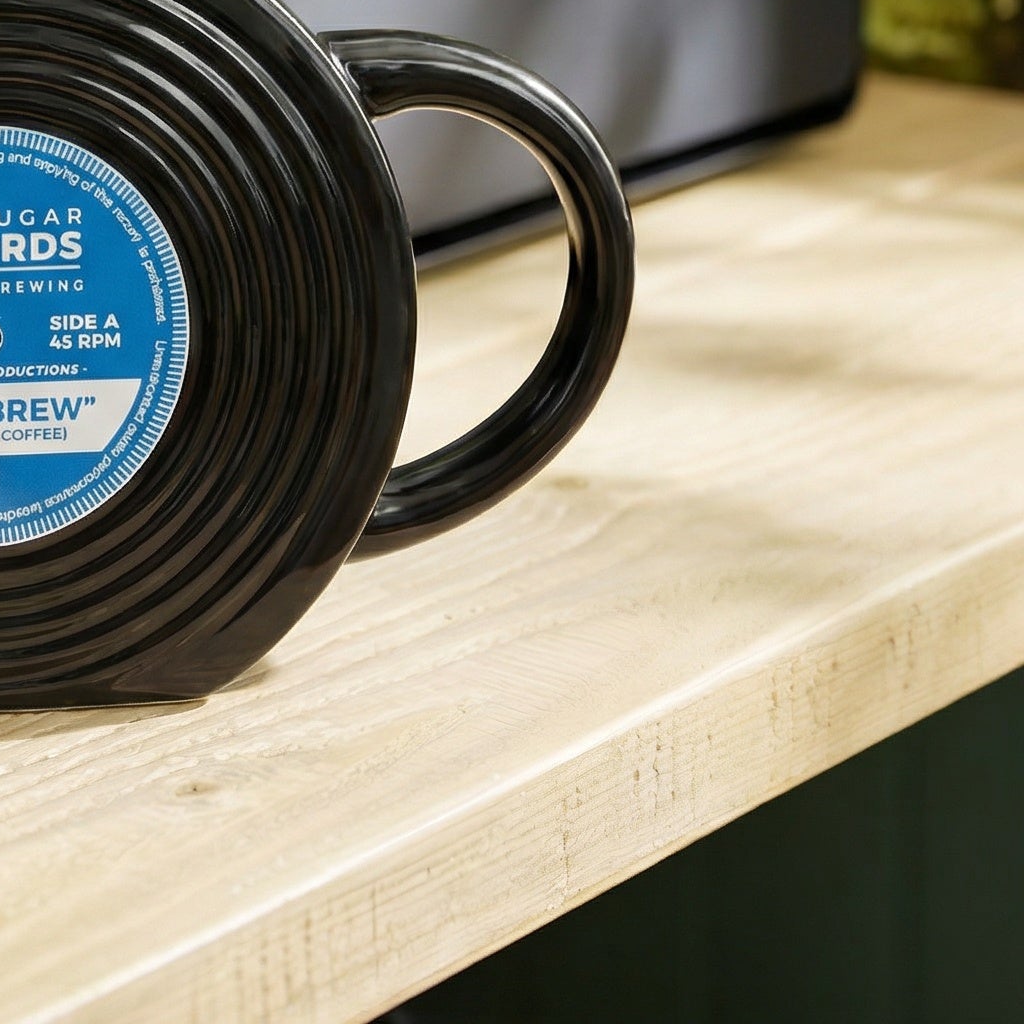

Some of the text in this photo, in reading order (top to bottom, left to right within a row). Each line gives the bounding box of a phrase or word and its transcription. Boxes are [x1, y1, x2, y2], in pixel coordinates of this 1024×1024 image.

[49, 313, 120, 331] SIDE A
[49, 332, 121, 350] 45 RPM
[0, 426, 68, 442] COFFEE)
